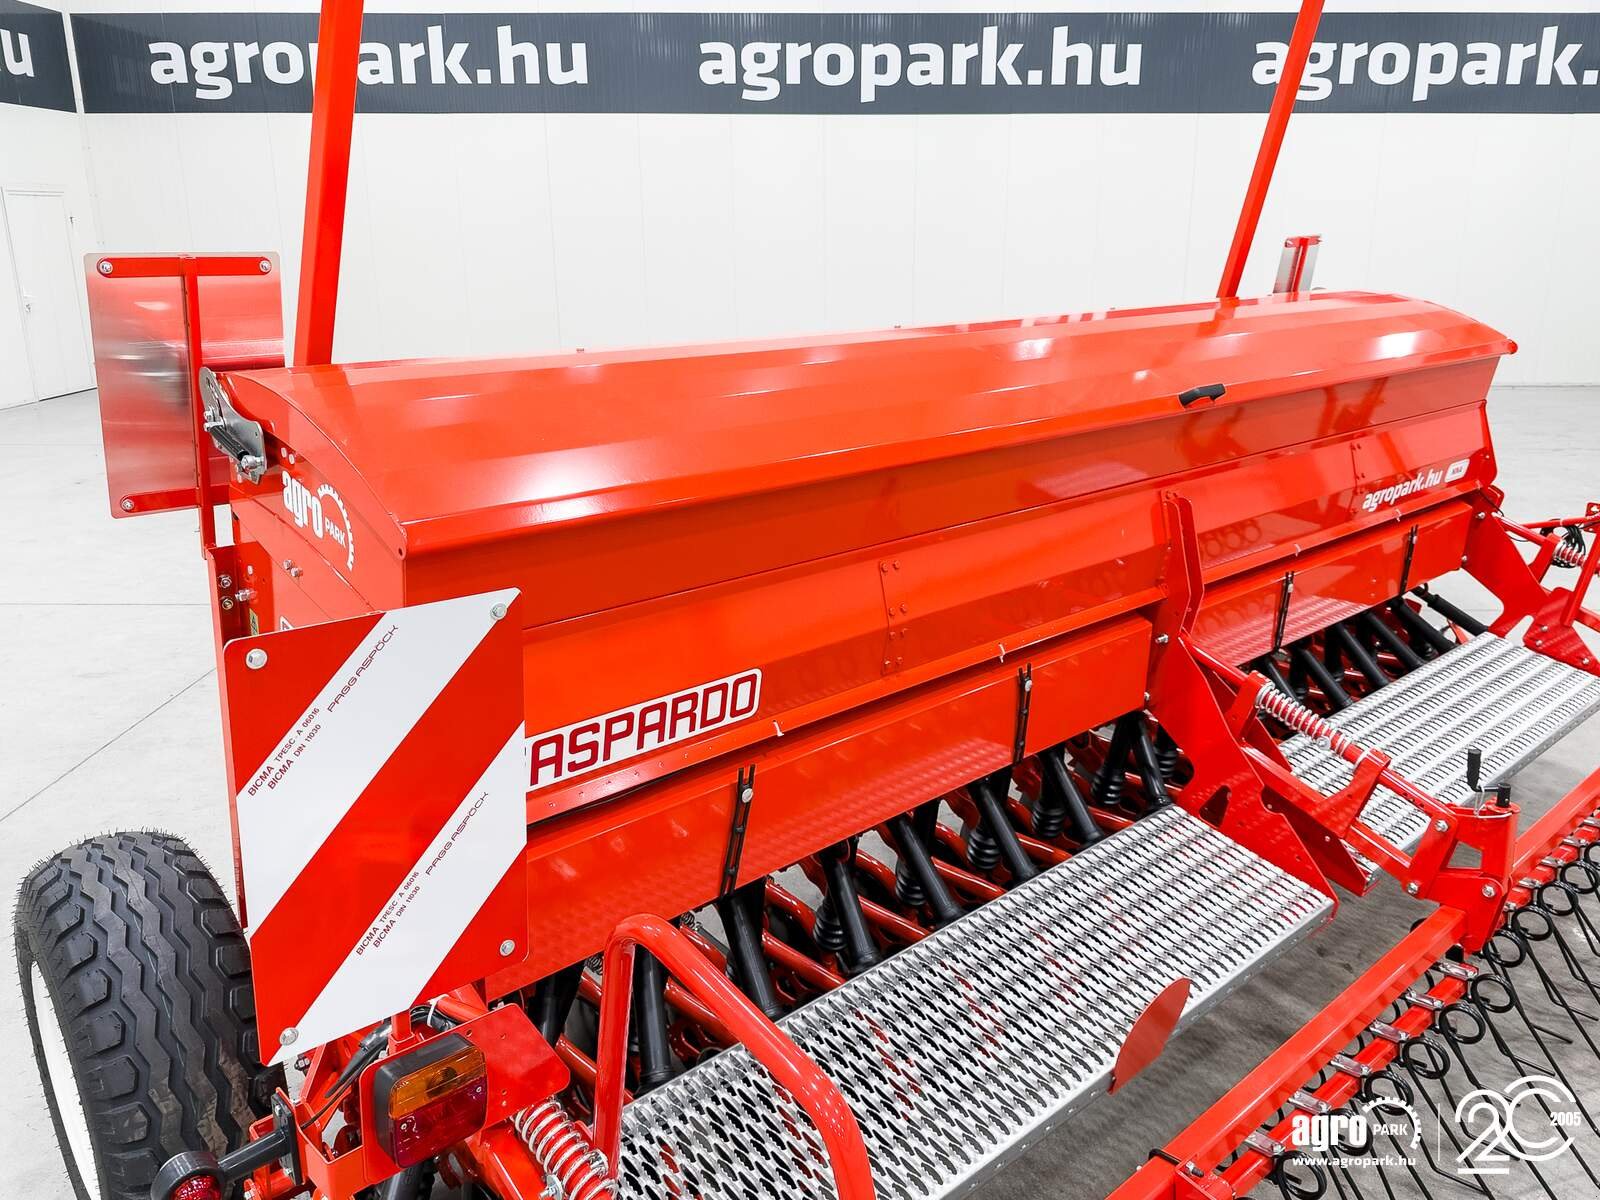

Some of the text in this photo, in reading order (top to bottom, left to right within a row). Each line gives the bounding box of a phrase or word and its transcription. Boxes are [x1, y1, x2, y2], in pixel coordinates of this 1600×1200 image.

[148, 25, 589, 100] agroark.hu
[698, 25, 1142, 103] agropark.hu
[282, 470, 346, 548] agro PARK
[1362, 468, 1443, 513] agropark.hu
[267, 724, 321, 790] BICMA DIN 11030
[525, 673, 758, 786] ASPARDO
[248, 765, 274, 796] BICMA
[274, 738, 296, 763] TPESC
[355, 926, 379, 956] BICMA
[372, 918, 396, 949] BICMA
[396, 904, 406, 917] DIN
